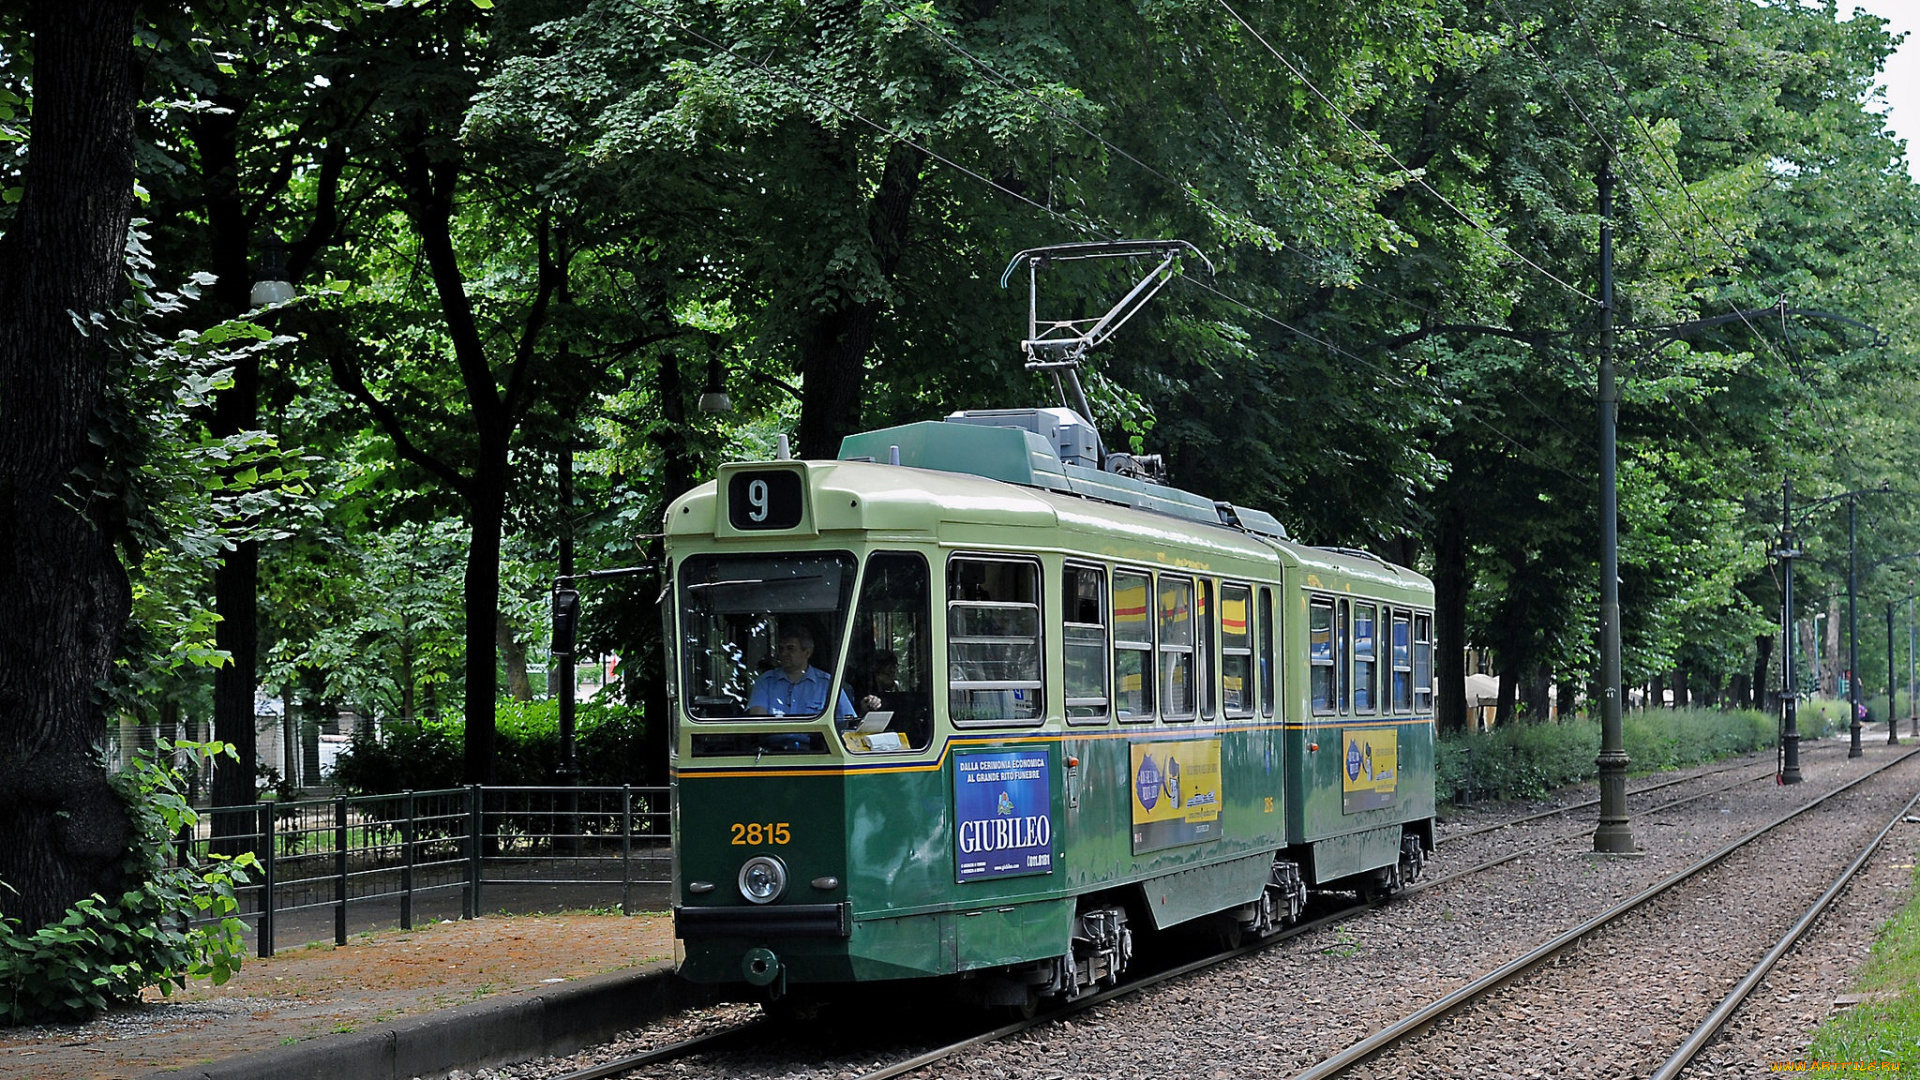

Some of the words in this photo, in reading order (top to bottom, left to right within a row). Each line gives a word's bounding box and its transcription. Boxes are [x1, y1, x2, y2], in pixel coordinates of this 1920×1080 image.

[749, 479, 768, 522] 9
[960, 762, 979, 771] DALLA
[980, 760, 1011, 770] CERIMONIA
[1012, 758, 1045, 769] ECONOMICA
[967, 774, 975, 783] AL
[976, 772, 1000, 782] GRANDE
[1001, 771, 1014, 781] RITO
[1015, 770, 1040, 780] FUNEBRE
[731, 823, 791, 845] 2815
[959, 814, 1051, 854] GIUBILEO
